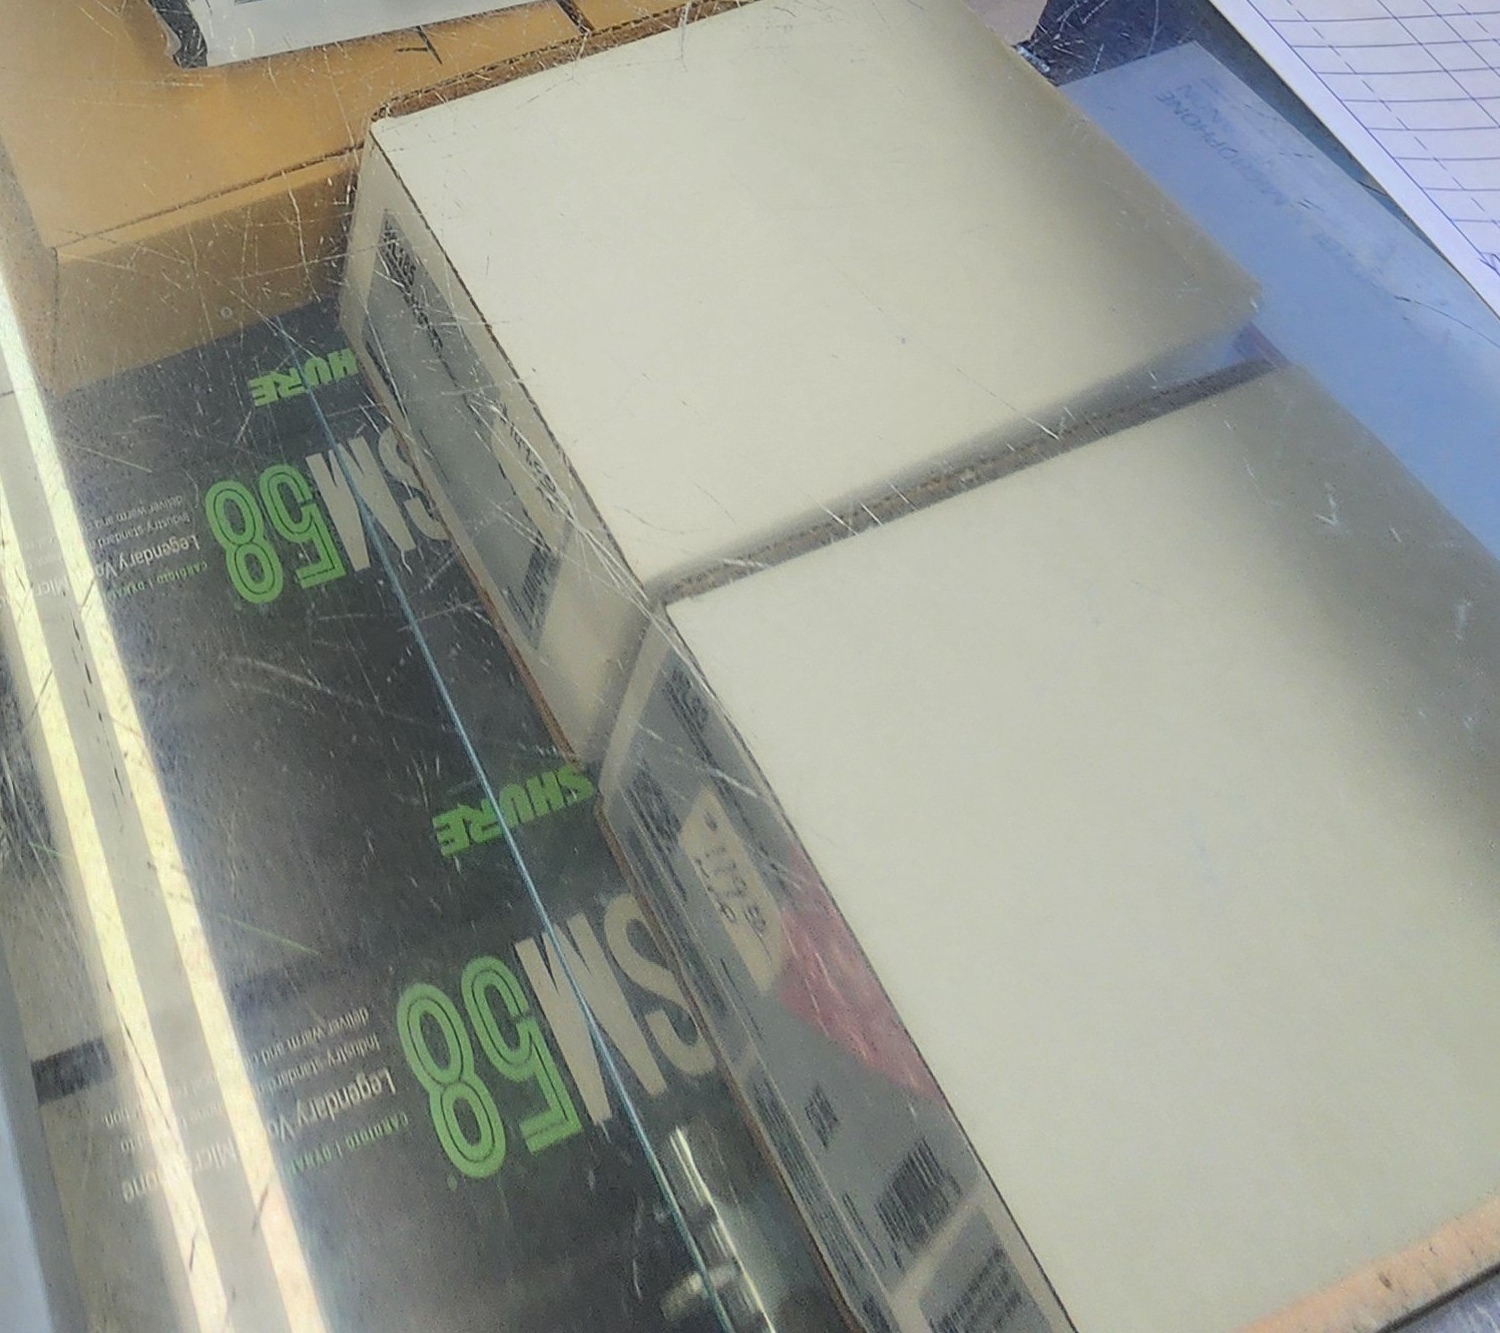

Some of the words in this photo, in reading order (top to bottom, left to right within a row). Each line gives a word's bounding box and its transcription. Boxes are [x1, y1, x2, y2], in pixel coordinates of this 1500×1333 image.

[250, 348, 358, 407] HURE
[120, 532, 200, 570] Legendary
[203, 426, 451, 607] SM58
[431, 765, 595, 857] SHURE
[396, 895, 719, 1178] SM58
[295, 1066, 398, 1128] Legendary
